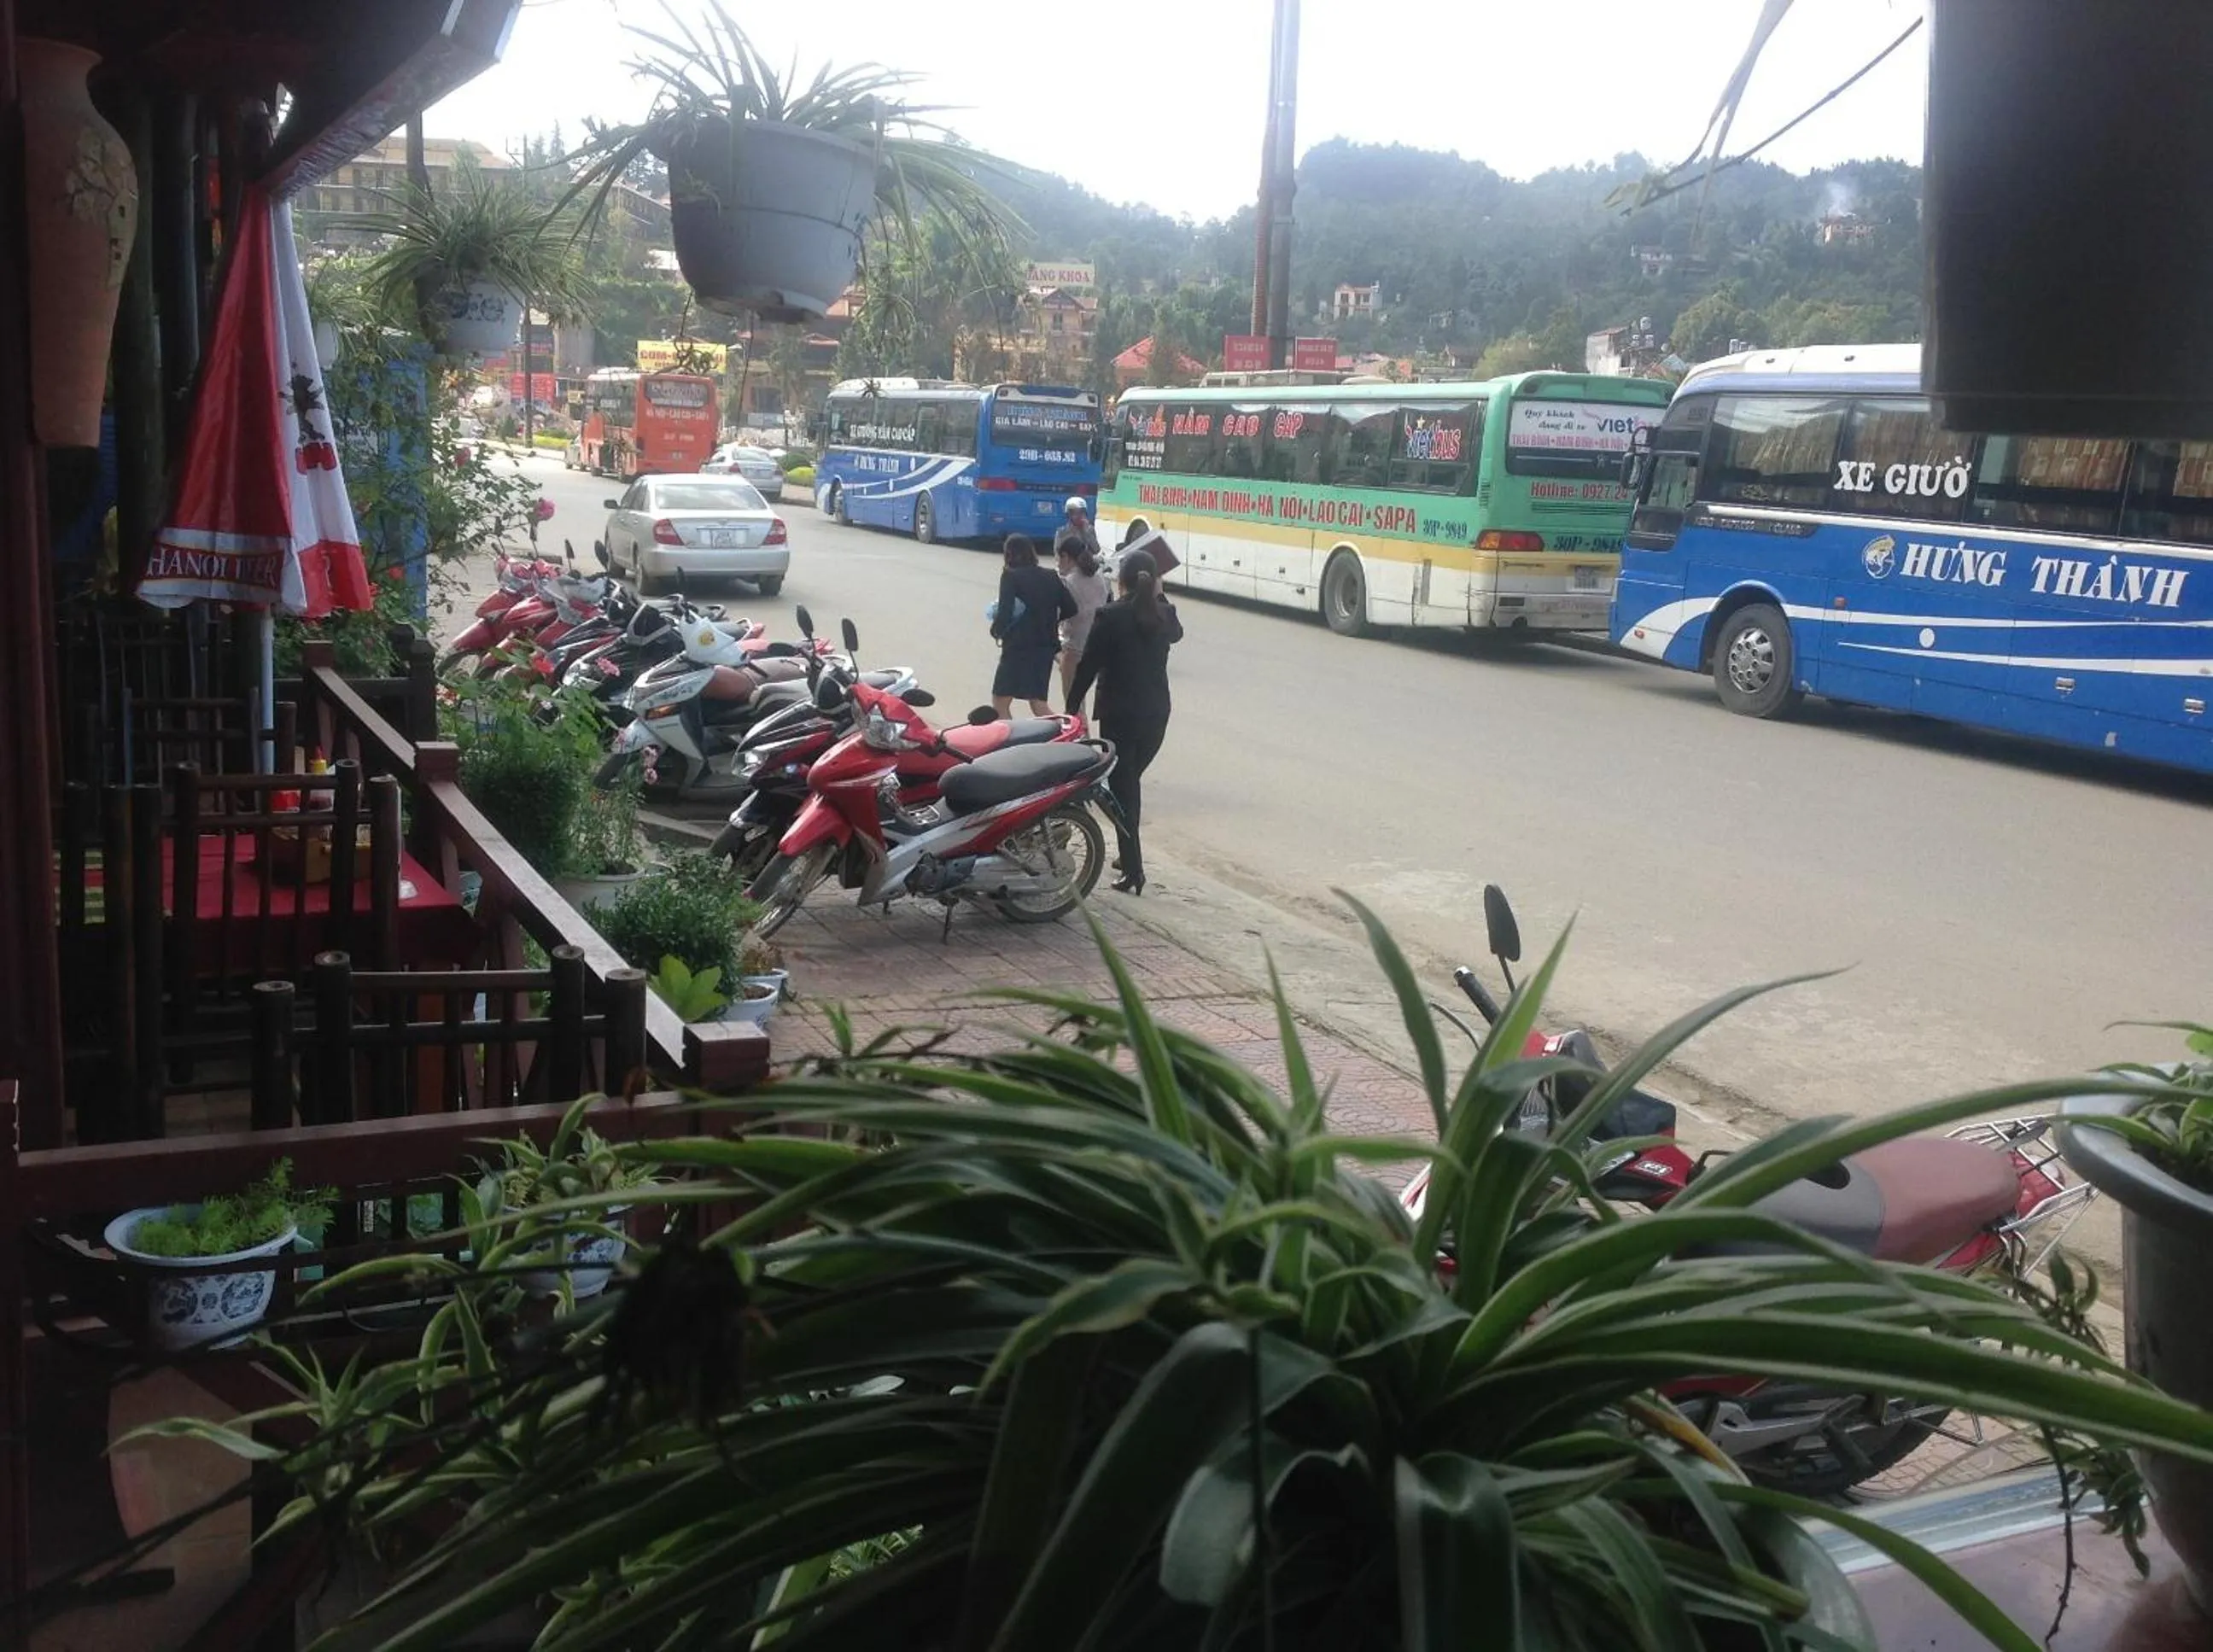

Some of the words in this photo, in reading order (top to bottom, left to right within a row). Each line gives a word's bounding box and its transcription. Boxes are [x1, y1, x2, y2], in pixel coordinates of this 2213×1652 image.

[1833, 460, 1877, 492] XE
[1884, 455, 1972, 499] GIƯỜ
[1193, 488, 1219, 511] NAM
[1339, 500, 1363, 527] CAI
[1374, 504, 1416, 534] SAPA
[145, 546, 226, 579] HANOI
[1899, 540, 2008, 587] HƯNG
[2030, 554, 2191, 608] THÀNH
